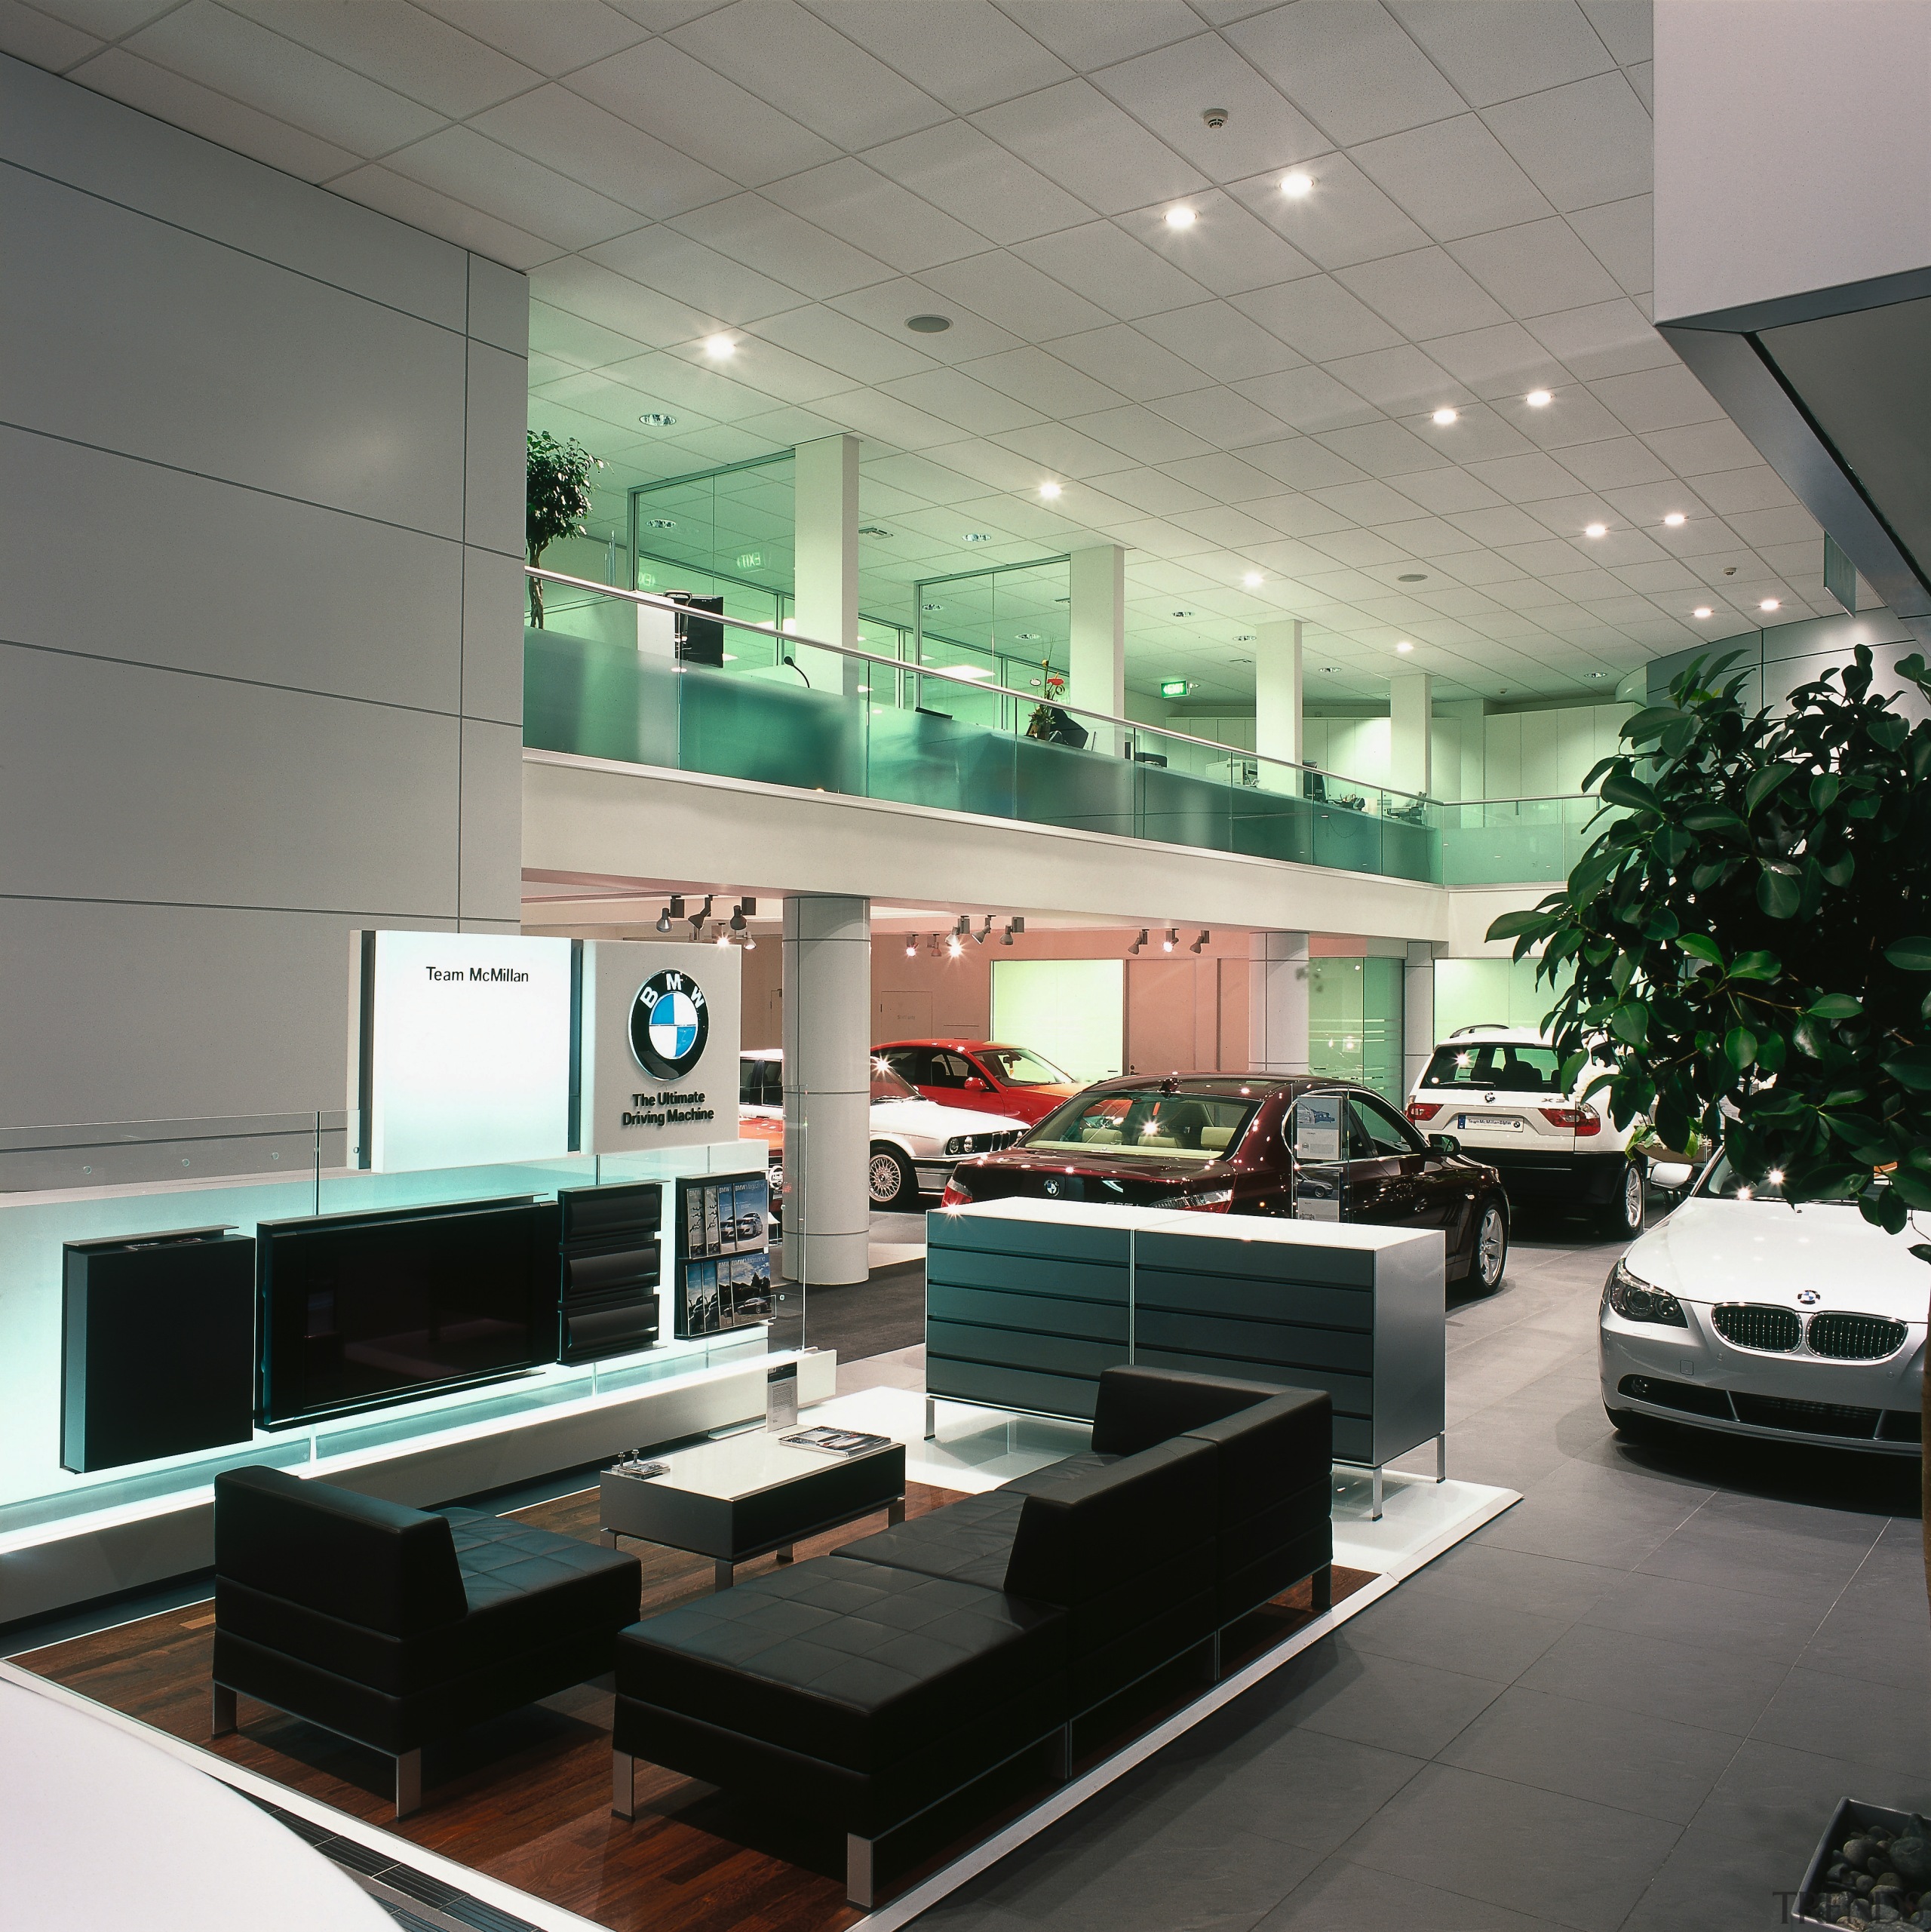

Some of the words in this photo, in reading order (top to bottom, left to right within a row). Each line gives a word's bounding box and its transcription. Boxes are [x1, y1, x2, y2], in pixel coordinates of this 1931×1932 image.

[425, 966, 464, 981] Team
[469, 967, 530, 982] McMillan
[640, 973, 705, 1009] BMW
[632, 1093, 656, 1107] The
[657, 1091, 705, 1106] Ultimate
[622, 1110, 665, 1126] Driving
[667, 1107, 715, 1123] Machine
[744, 1255, 766, 1264] Magazine
